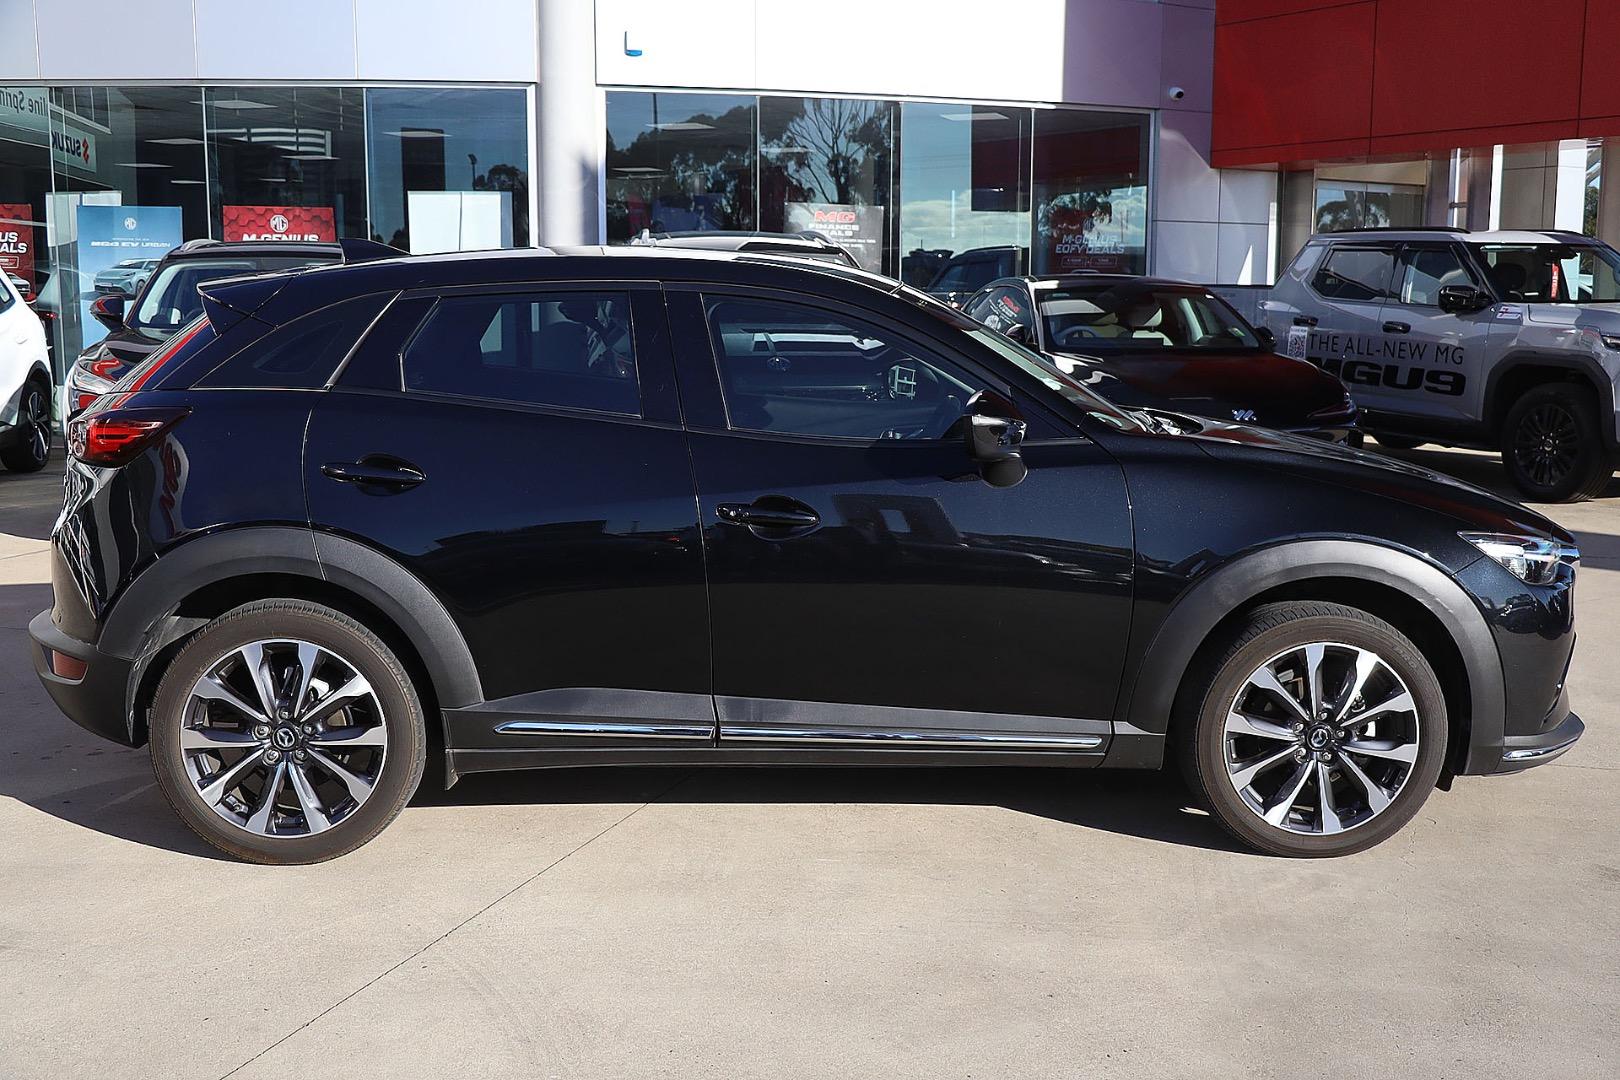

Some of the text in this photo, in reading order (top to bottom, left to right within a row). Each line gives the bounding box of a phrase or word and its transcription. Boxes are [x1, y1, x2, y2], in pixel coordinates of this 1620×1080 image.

[269, 214, 289, 233] MG
[814, 211, 856, 223] MG
[1086, 243, 1126, 254] DEALS
[1309, 333, 1465, 366] THE ALL-NEW MG
